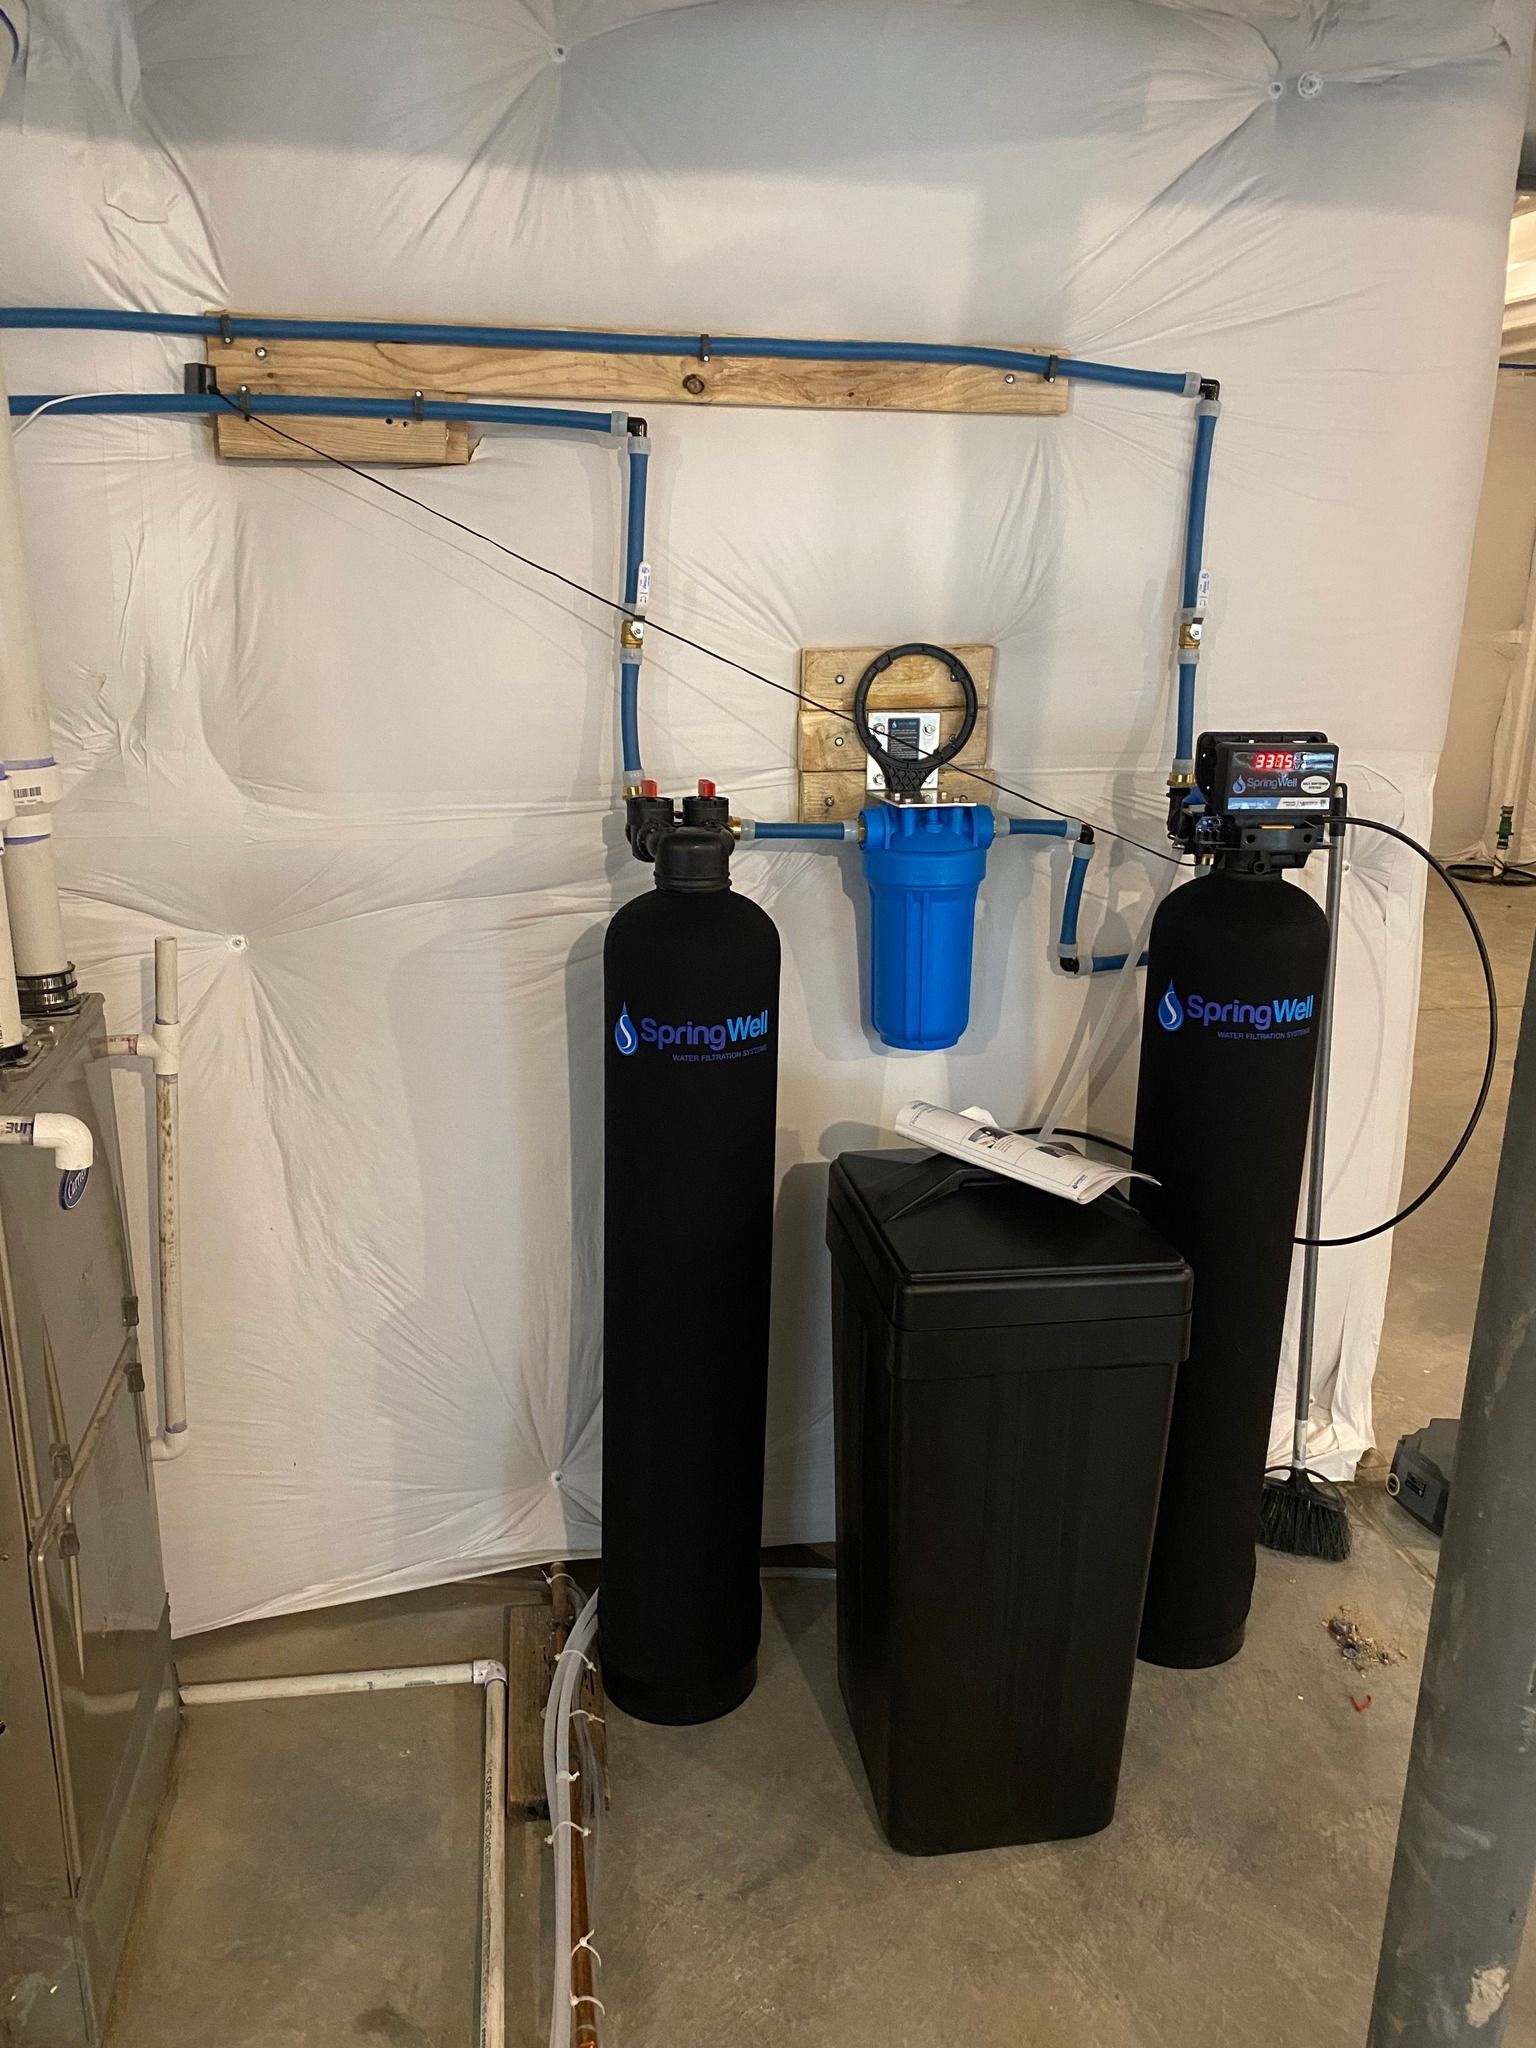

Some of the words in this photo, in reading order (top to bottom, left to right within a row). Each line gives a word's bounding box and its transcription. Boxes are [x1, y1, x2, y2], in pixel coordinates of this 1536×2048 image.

[1187, 994, 1314, 1031] SpringWell
[640, 1009, 769, 1051] SpringWell
[1217, 1031, 1244, 1039] WATER
[672, 1054, 699, 1062] WATER
[701, 1051, 741, 1062] FILTRATION
